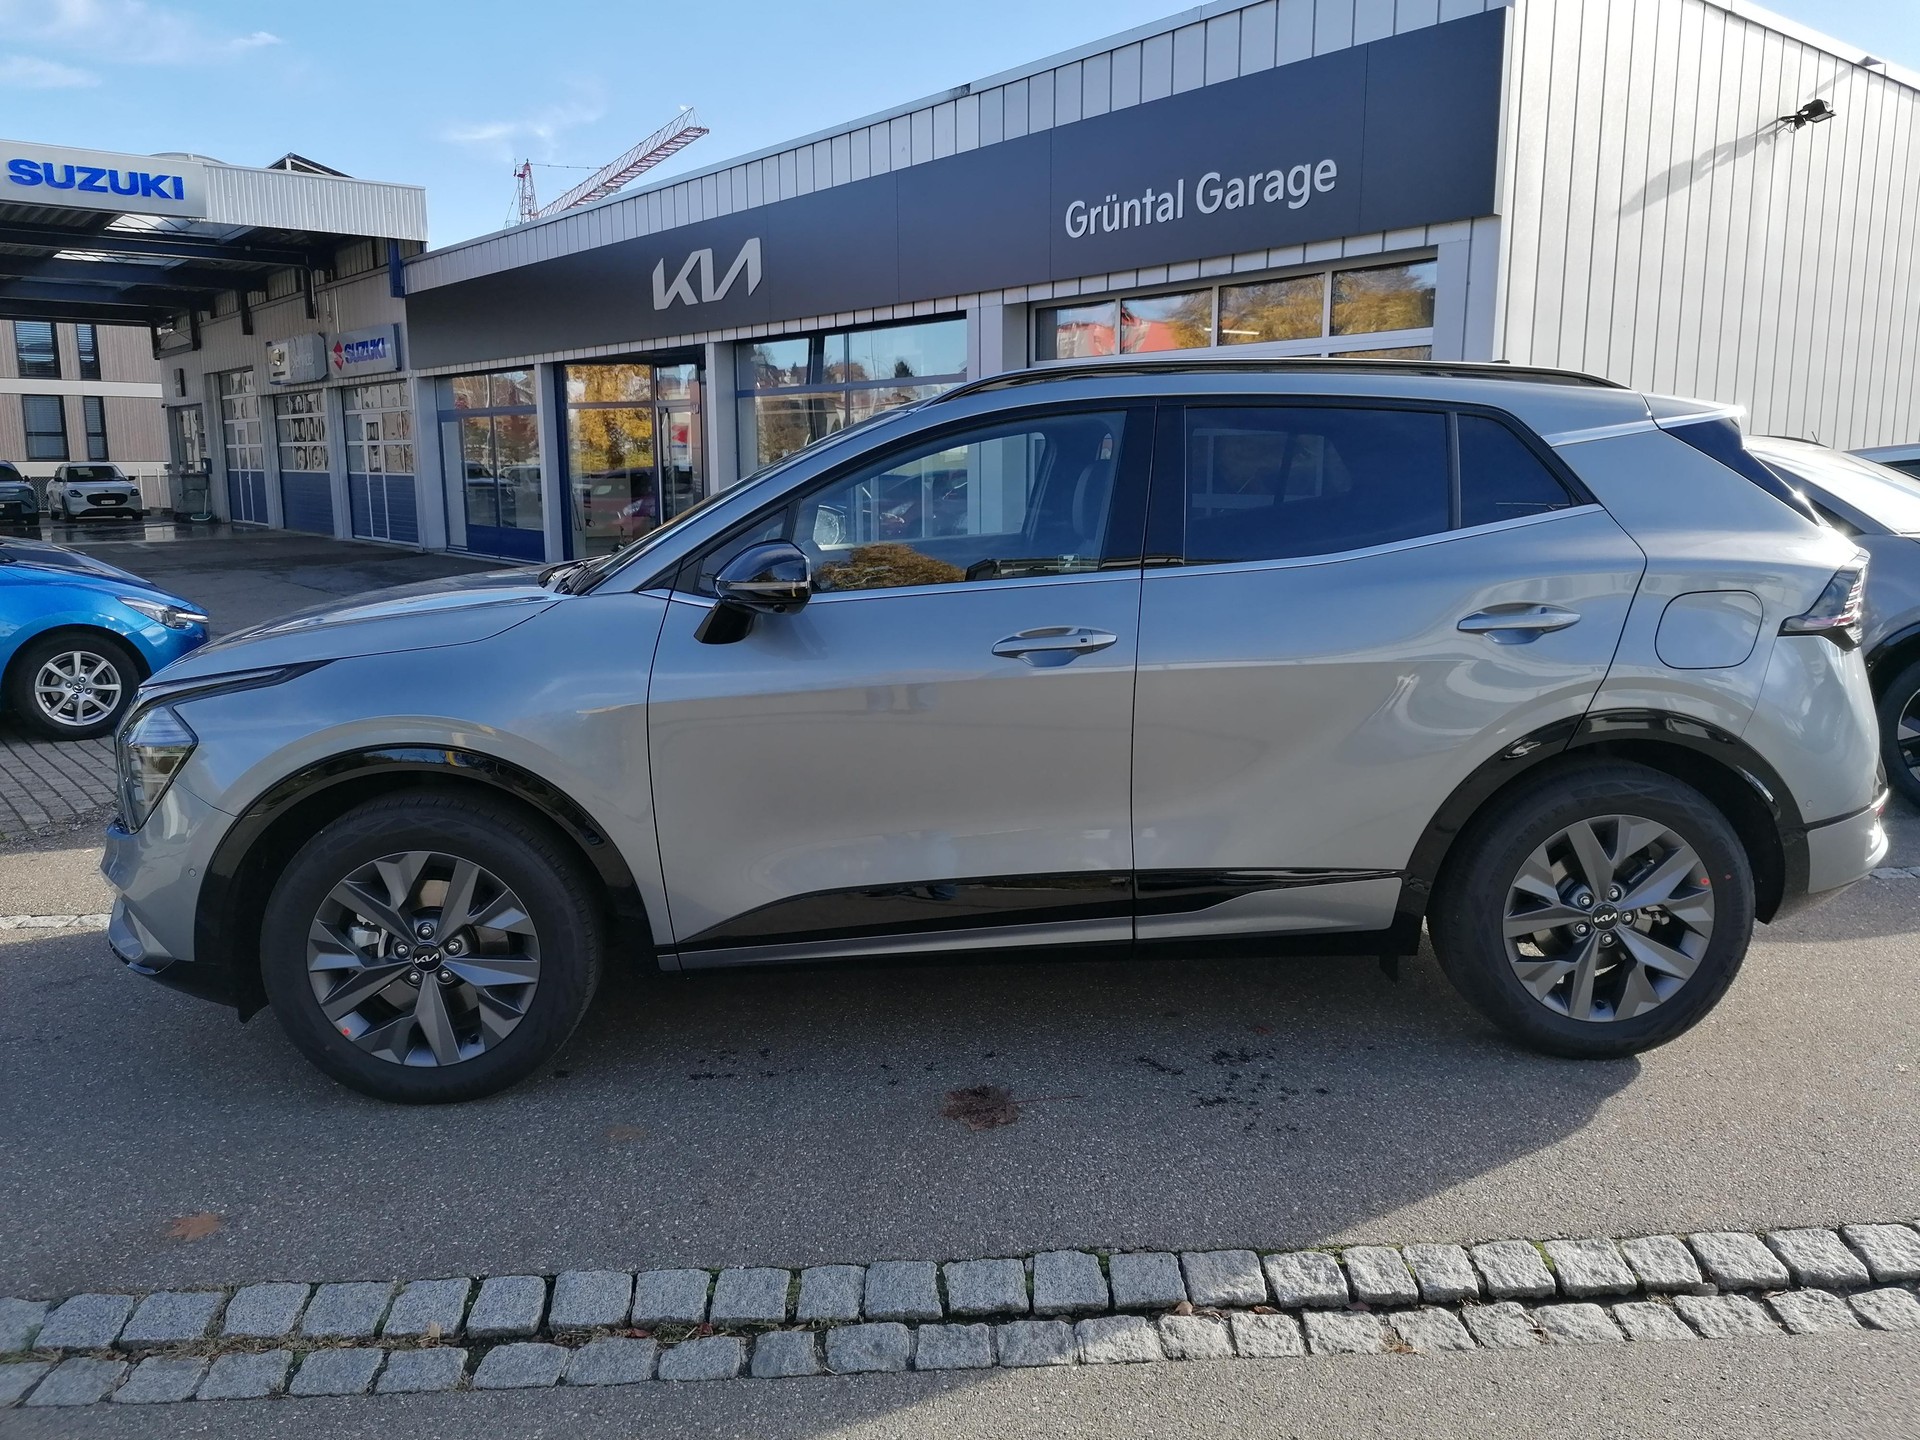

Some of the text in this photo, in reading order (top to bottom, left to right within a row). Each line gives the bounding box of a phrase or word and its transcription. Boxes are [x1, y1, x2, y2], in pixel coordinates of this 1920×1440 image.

[8, 159, 184, 199] SUZUKI
[1065, 159, 1337, 238] Grüntal Garage
[652, 237, 762, 310] KIA
[344, 338, 386, 364] SUZUKI
